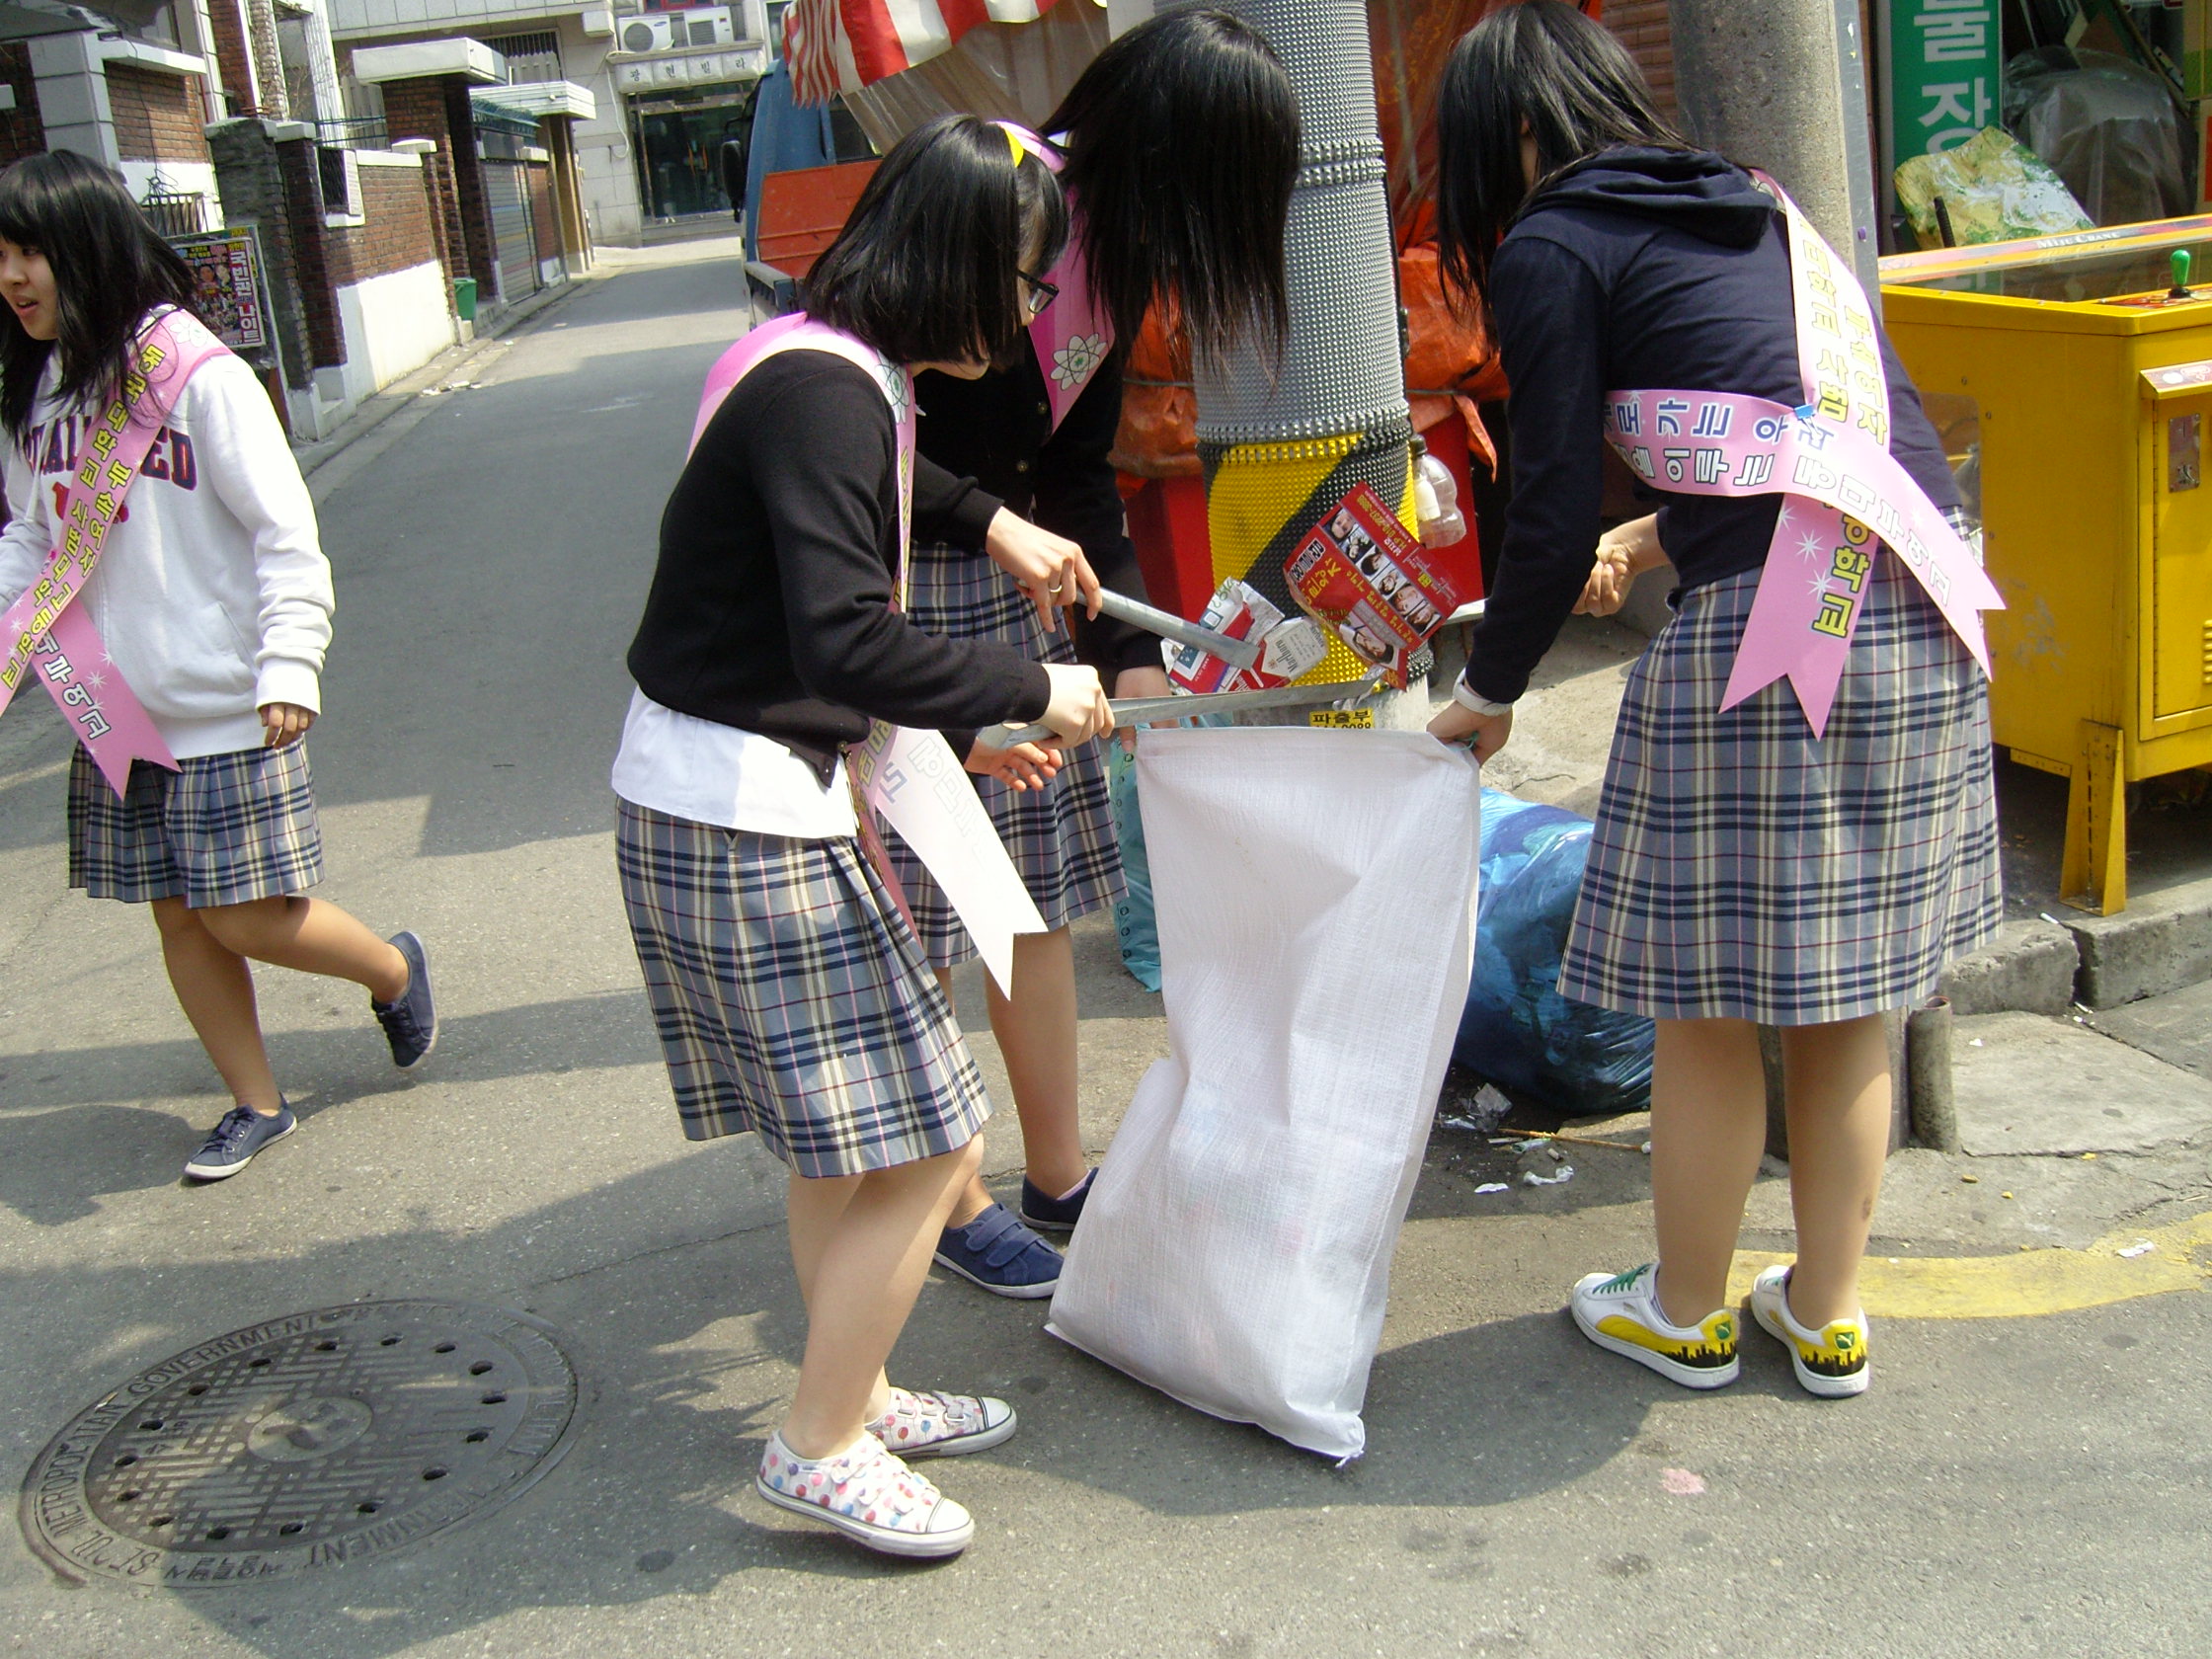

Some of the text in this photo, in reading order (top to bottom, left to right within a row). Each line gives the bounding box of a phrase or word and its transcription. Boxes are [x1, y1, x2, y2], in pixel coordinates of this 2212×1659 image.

[238, 303, 262, 344] 나이트
[1800, 222, 1841, 338] 대학교
[1657, 397, 1733, 437] 가는
[34, 344, 166, 607] 동국대학교 사범대학
[1664, 447, 1776, 487] 이루는
[1792, 454, 1952, 607] 동대부여고
[1, 459, 133, 690] 부속여자 고등학교
[35, 629, 112, 740] 대부여고
[1276, 639, 1300, 672] Marlboro
[128, 1313, 317, 1396] GOVERNMENT
